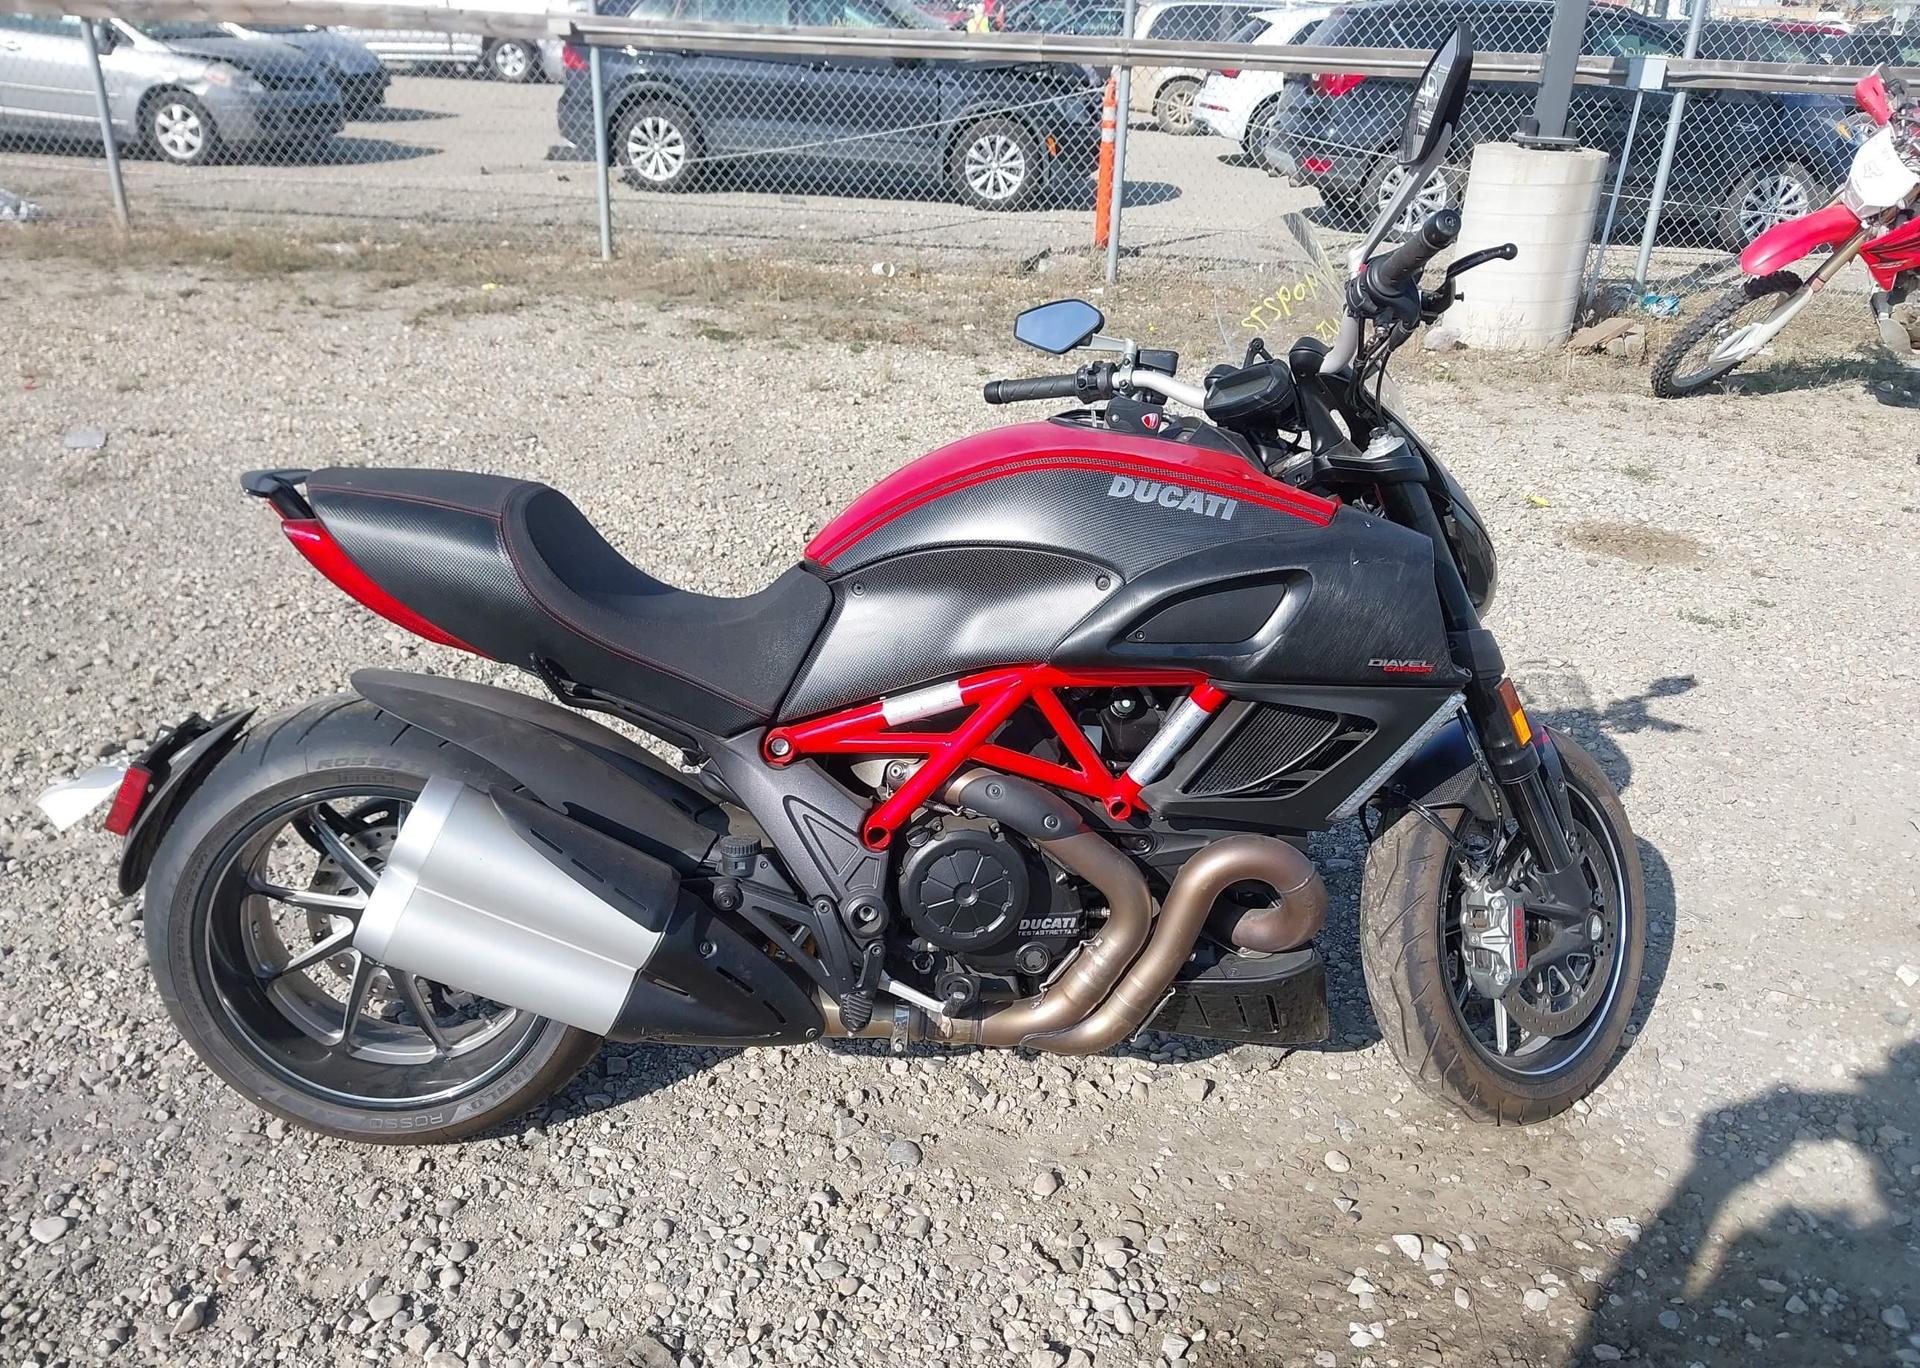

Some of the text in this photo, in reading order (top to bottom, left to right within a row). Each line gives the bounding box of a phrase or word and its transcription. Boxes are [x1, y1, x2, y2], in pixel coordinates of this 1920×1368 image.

[1108, 475, 1238, 521] DUCATI
[1367, 659, 1435, 667] DIAVEL
[1019, 917, 1077, 929] DUCATI
[370, 1113, 443, 1128] ROSSO
